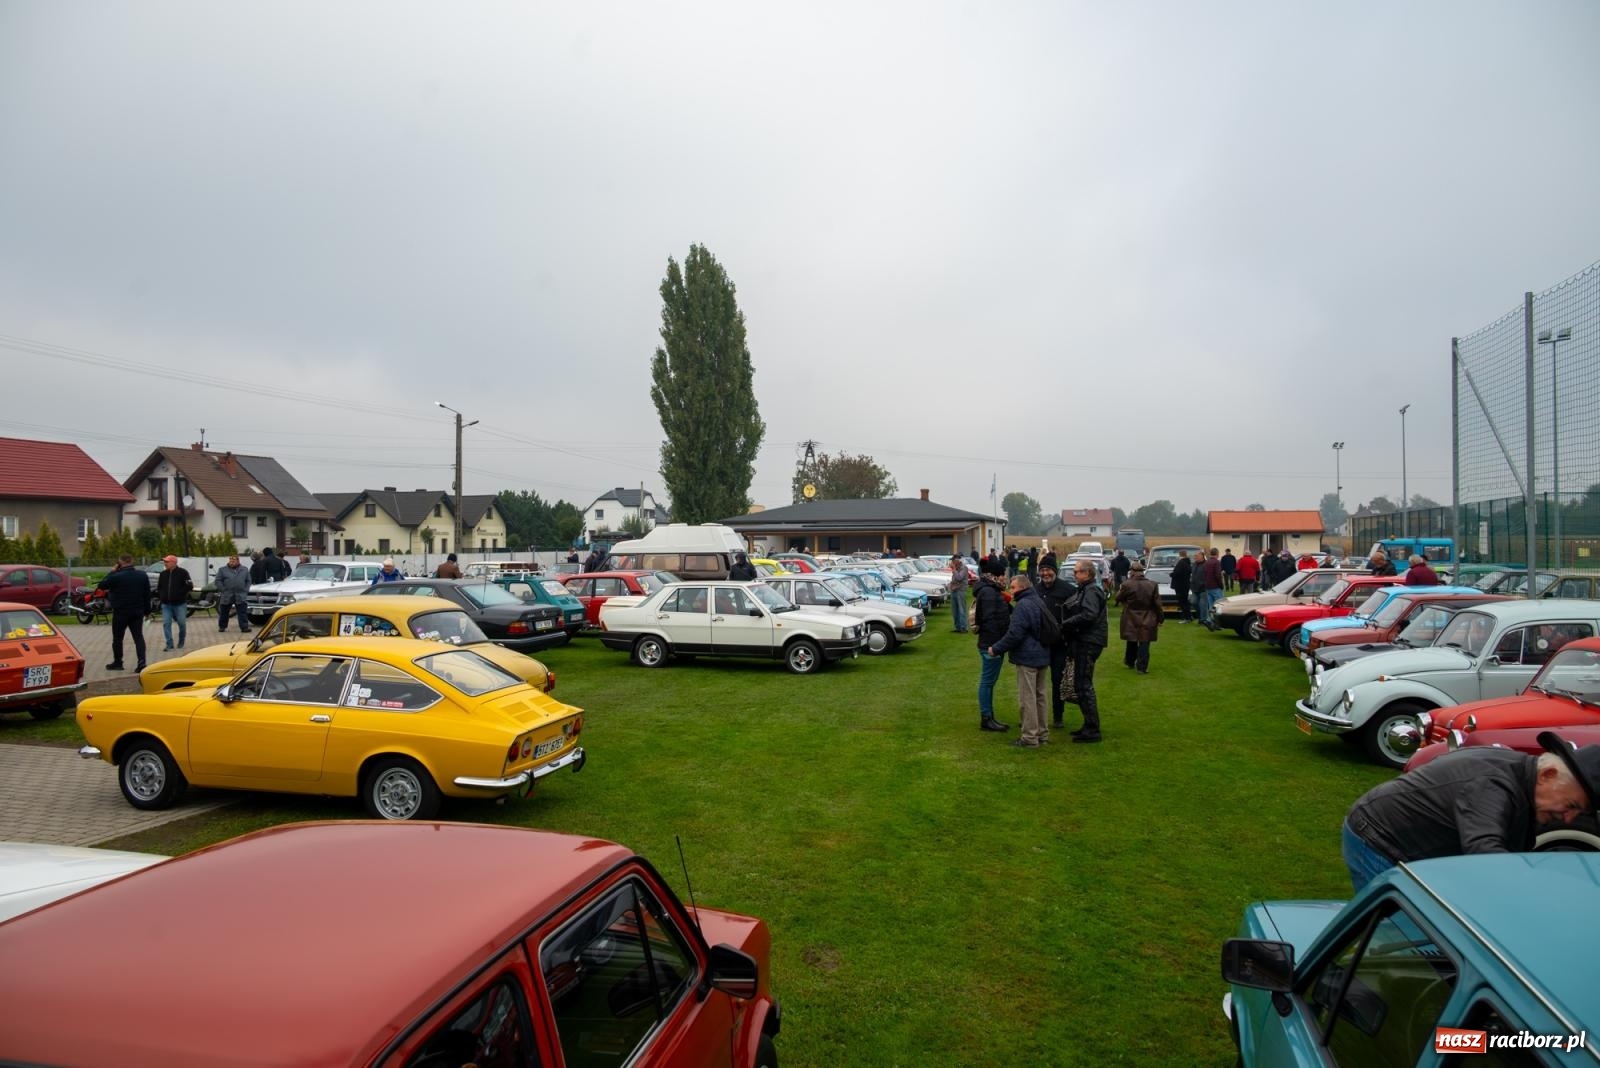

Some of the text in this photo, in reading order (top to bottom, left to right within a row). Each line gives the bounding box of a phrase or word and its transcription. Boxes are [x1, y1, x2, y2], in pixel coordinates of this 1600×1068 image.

[343, 624, 352, 634] 40
[30, 666, 48, 677] SRC
[25, 676, 49, 687] FY99
